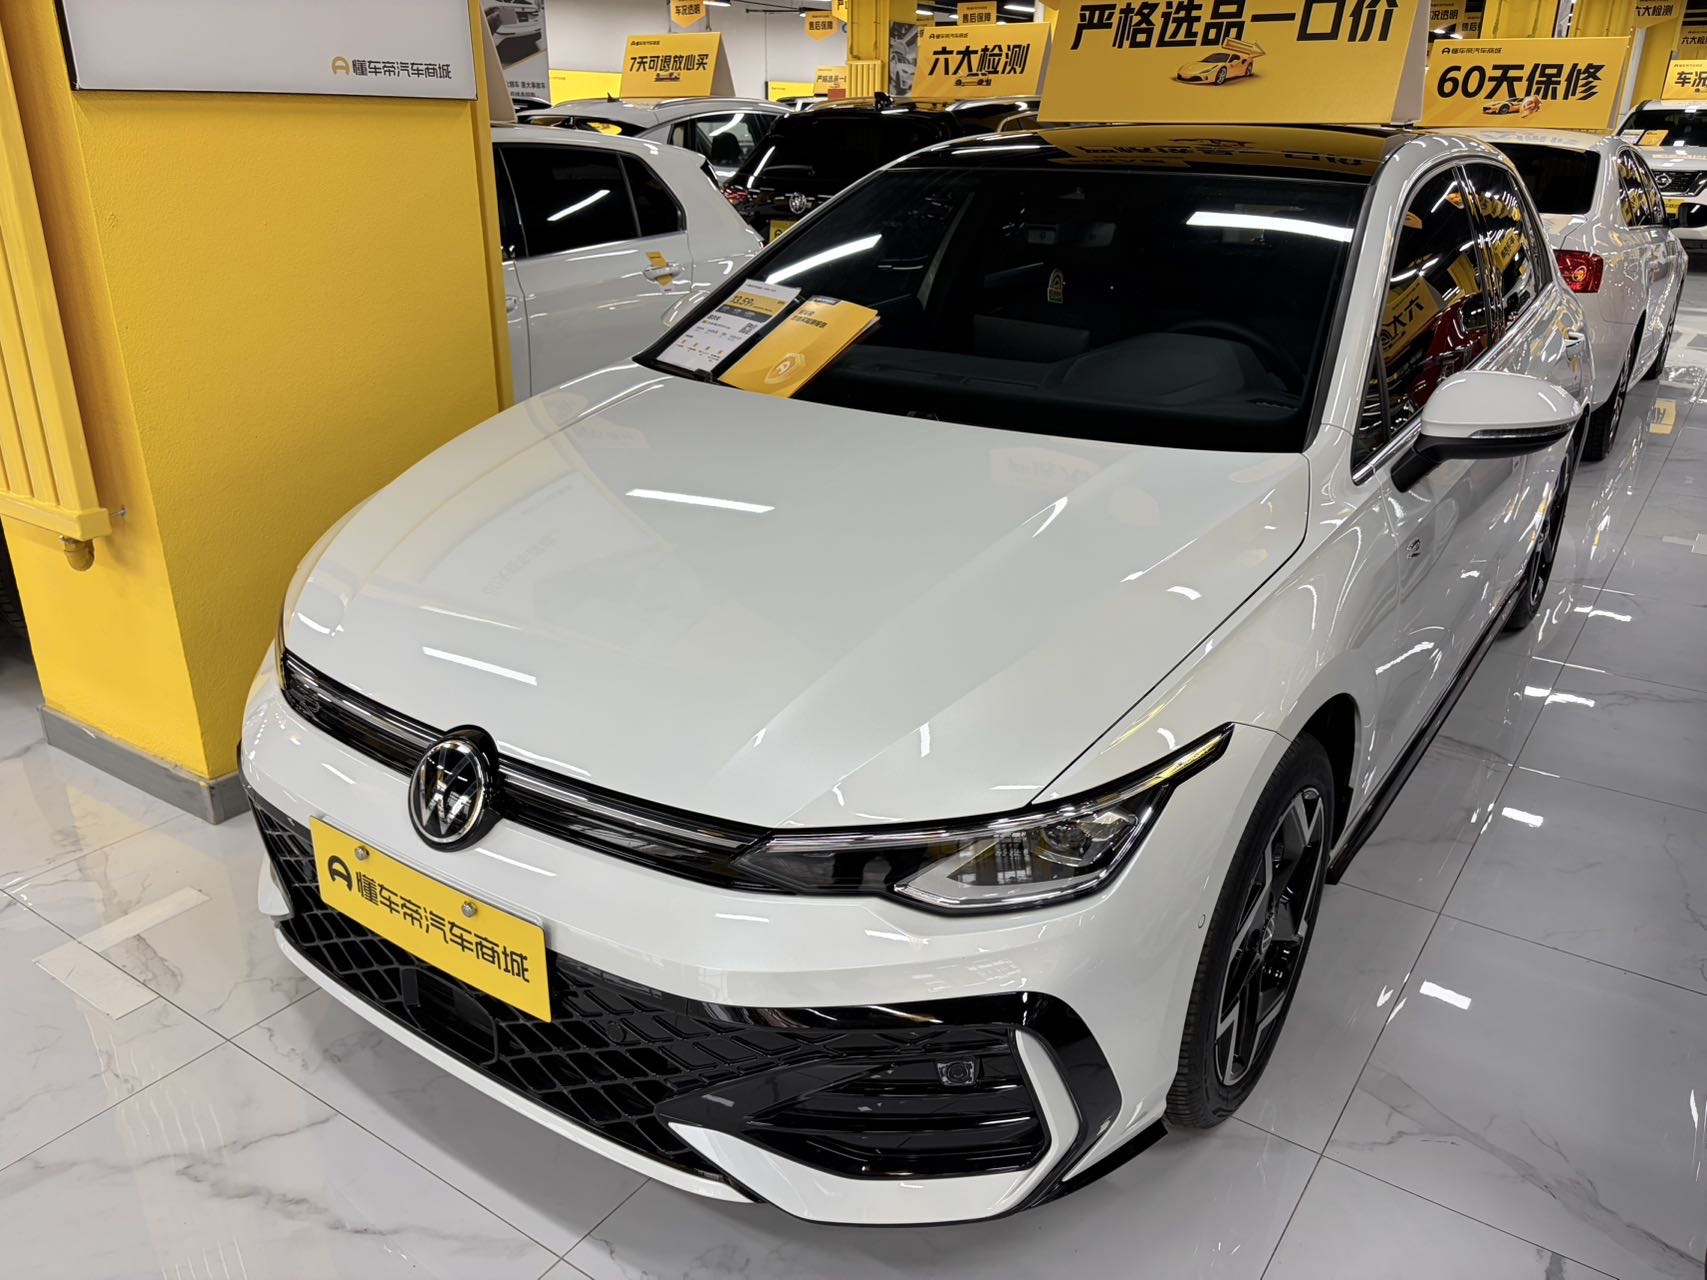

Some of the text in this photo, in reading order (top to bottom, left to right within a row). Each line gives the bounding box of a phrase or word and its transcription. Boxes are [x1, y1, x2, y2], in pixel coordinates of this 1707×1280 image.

[1071, 0, 1399, 50] 严格选品一口价
[629, 53, 710, 73] 7天可退放心买
[928, 43, 1031, 76] 六大检测
[1436, 63, 1606, 101] 60天保修
[355, 870, 531, 984] 懂车帝汽车商城
